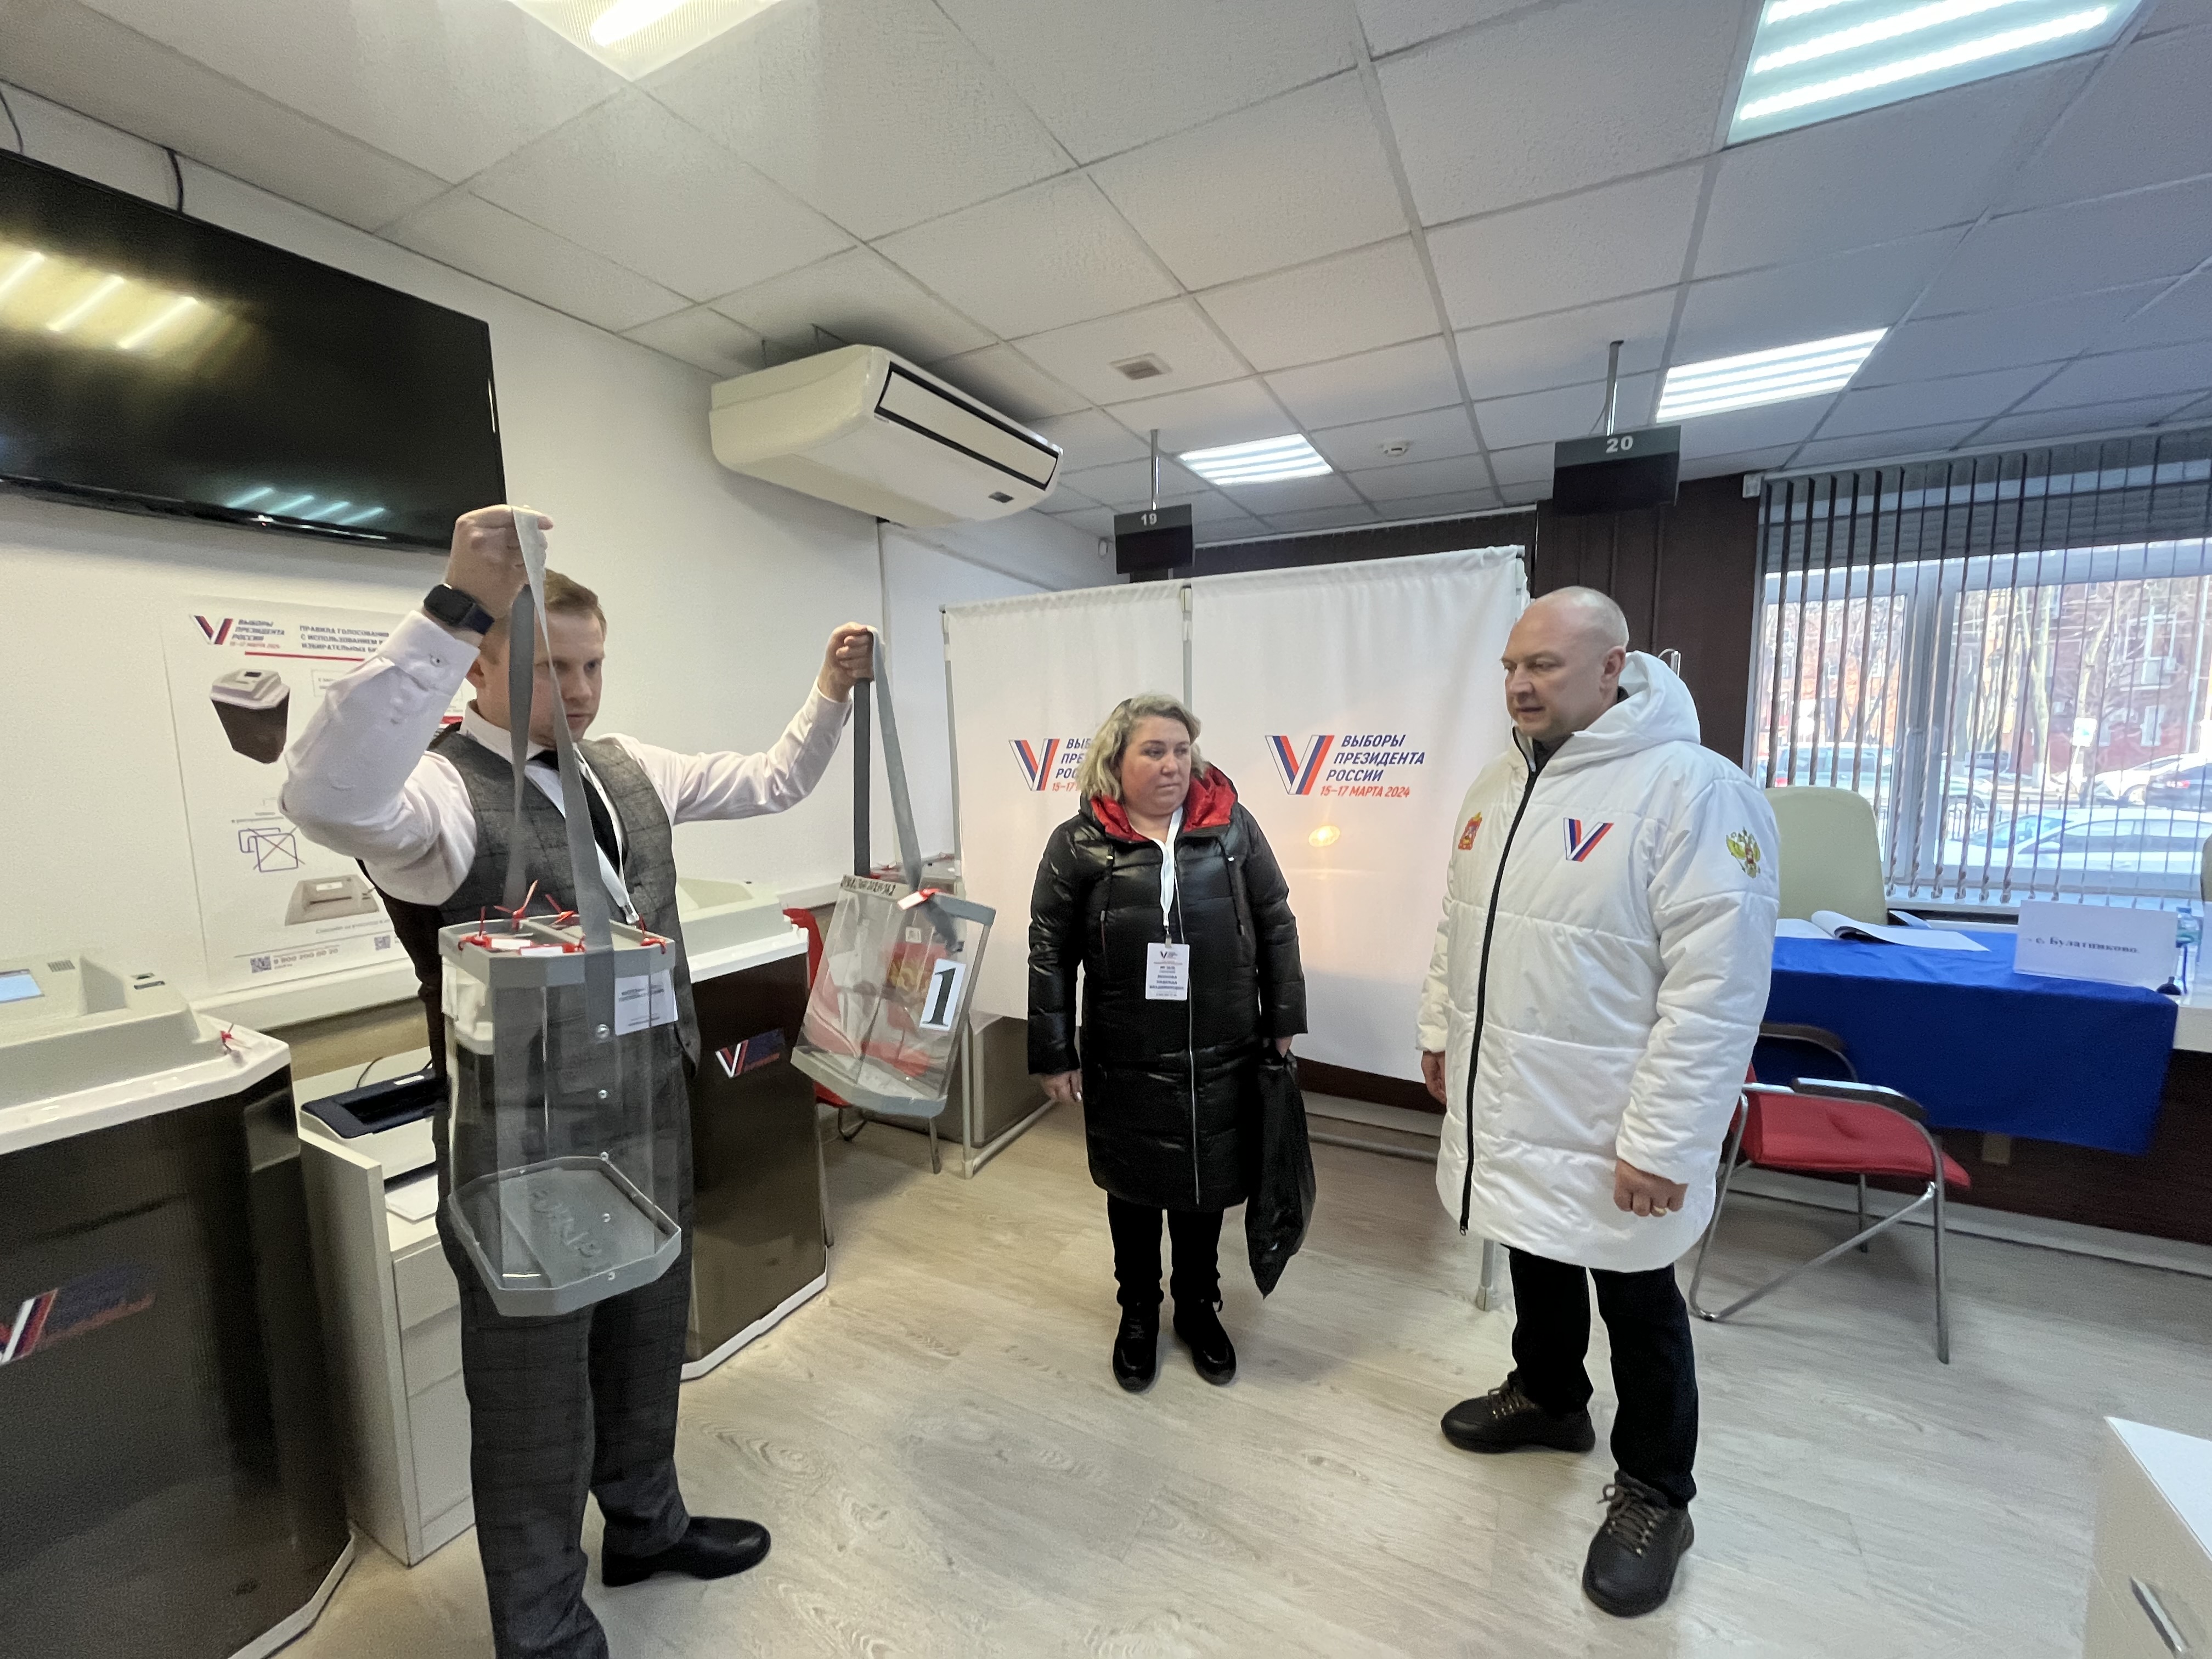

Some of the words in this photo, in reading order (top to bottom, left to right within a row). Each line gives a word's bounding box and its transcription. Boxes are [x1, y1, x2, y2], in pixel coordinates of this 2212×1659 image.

[1605, 436, 1634, 454] 20
[1141, 513, 1158, 526] 19
[300, 625, 336, 634] ПРАВИЛА
[1341, 734, 1406, 747] ВЫБОРЫ
[1333, 752, 1425, 767] ПРЕЗИДЕНТА
[1325, 769, 1384, 782] РОССИИ
[1349, 786, 1384, 797] МАРТА
[1384, 786, 1410, 798] 2024
[922, 967, 957, 1028] 1
